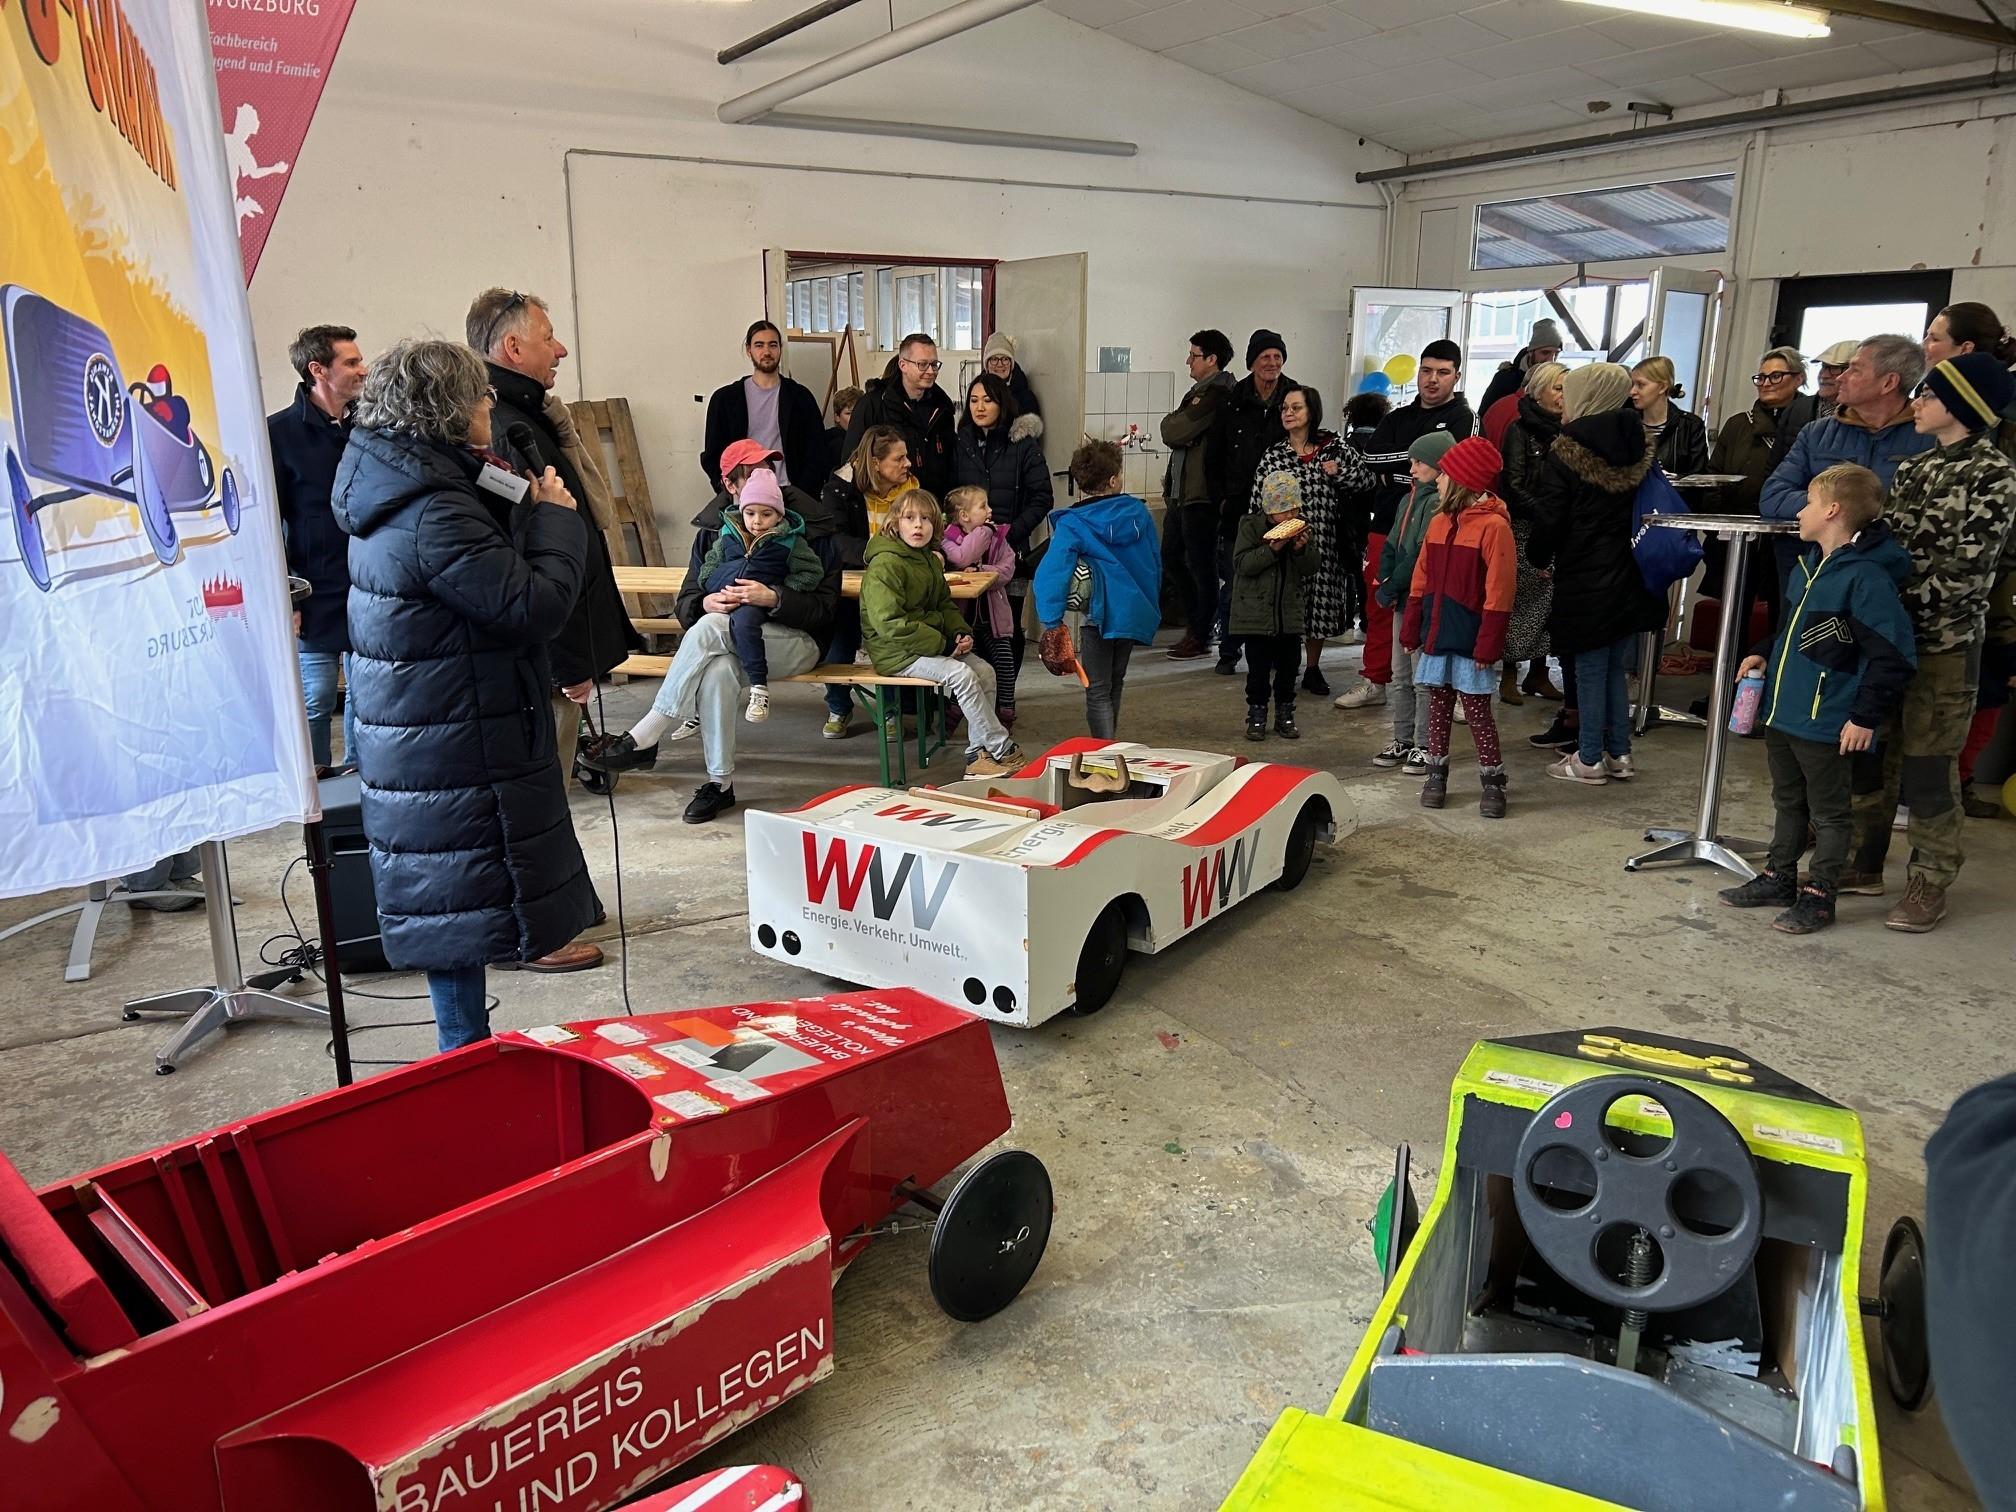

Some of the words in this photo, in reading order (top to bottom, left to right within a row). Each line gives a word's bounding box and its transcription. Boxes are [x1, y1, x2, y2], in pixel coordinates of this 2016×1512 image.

[212, 56, 246, 71] gend
[249, 60, 272, 73] und
[276, 61, 320, 77] Familie
[874, 803, 1011, 833] WVV
[802, 831, 960, 931] WVV
[802, 906, 852, 930] Energie.
[854, 919, 907, 944] Verkehr.
[1182, 828, 1261, 930] WVV
[395, 1366, 643, 1512] BAUEREIS
[612, 1318, 825, 1469] KOLLEGEN
